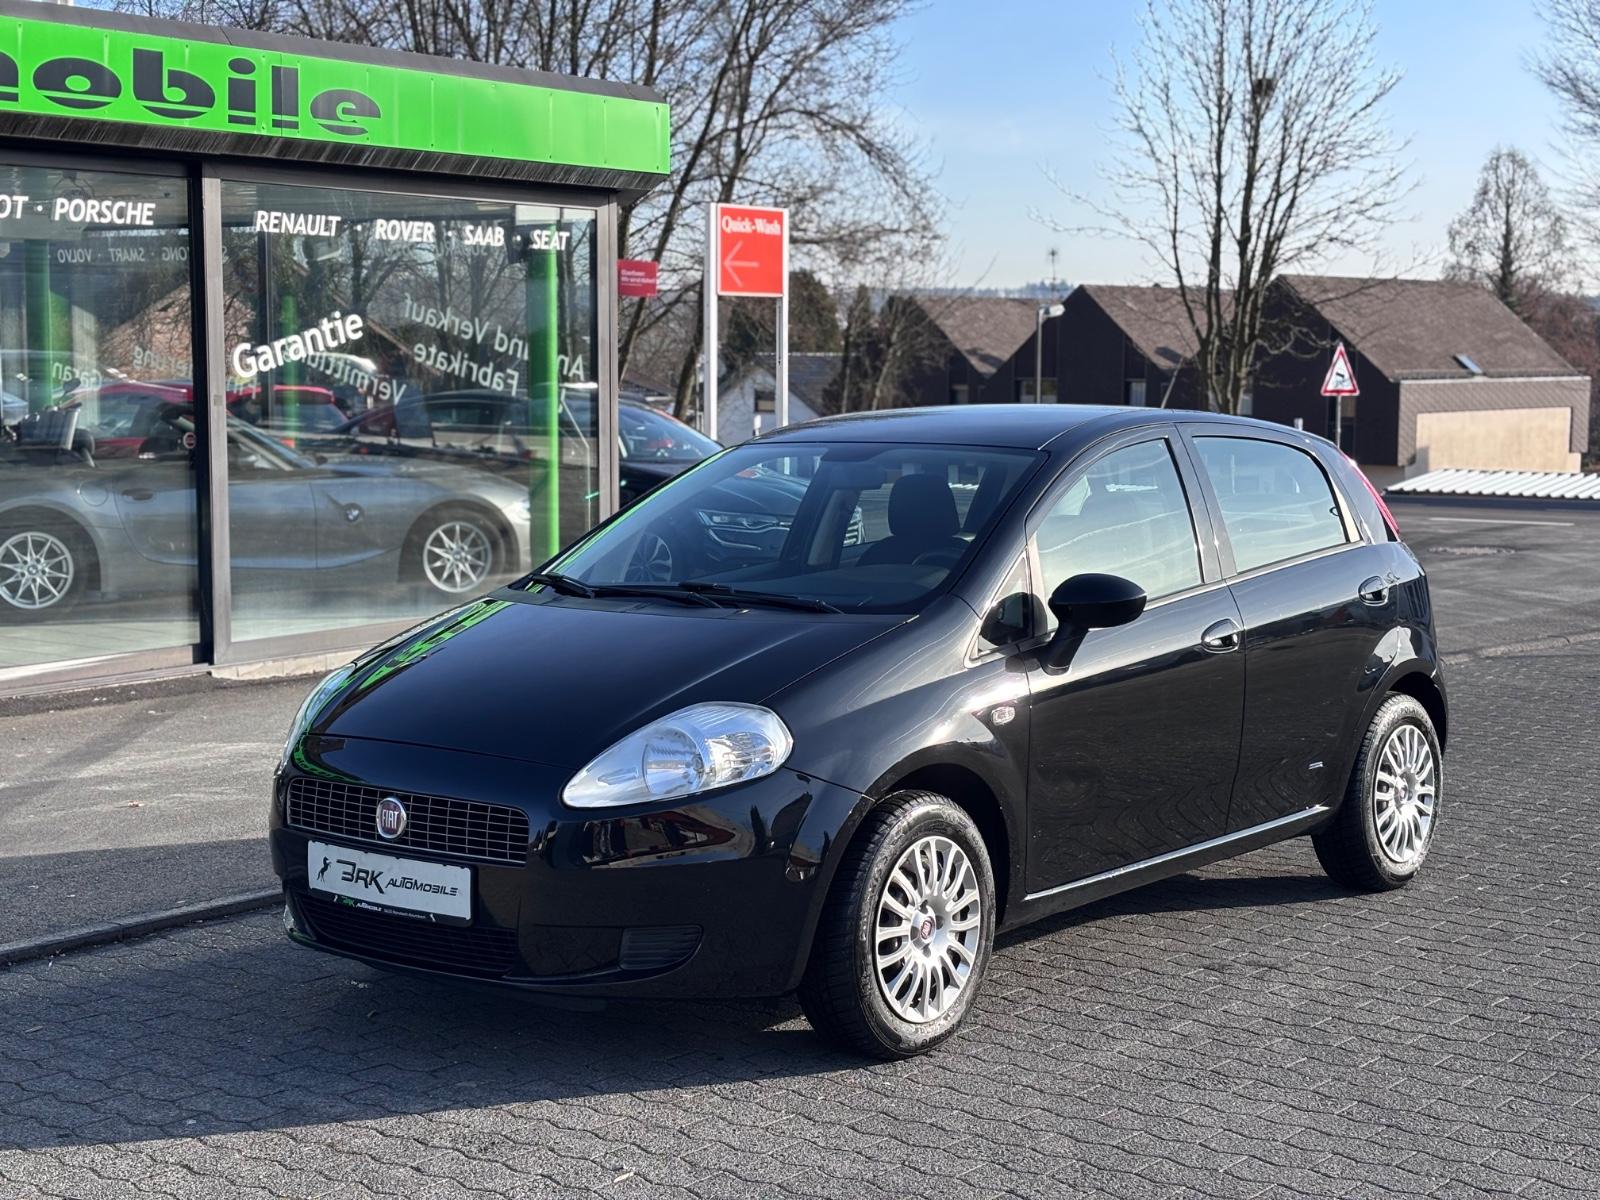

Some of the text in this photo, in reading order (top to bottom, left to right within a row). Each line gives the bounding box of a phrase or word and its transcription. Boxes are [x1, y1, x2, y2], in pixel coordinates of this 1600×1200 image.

[54, 197, 156, 225] PORSCHE
[256, 210, 570, 251] RENAULT ROVER SAAB SEAT
[721, 215, 782, 236] Quick-Wash
[233, 311, 363, 379] Garantie
[382, 809, 400, 829] FIAT
